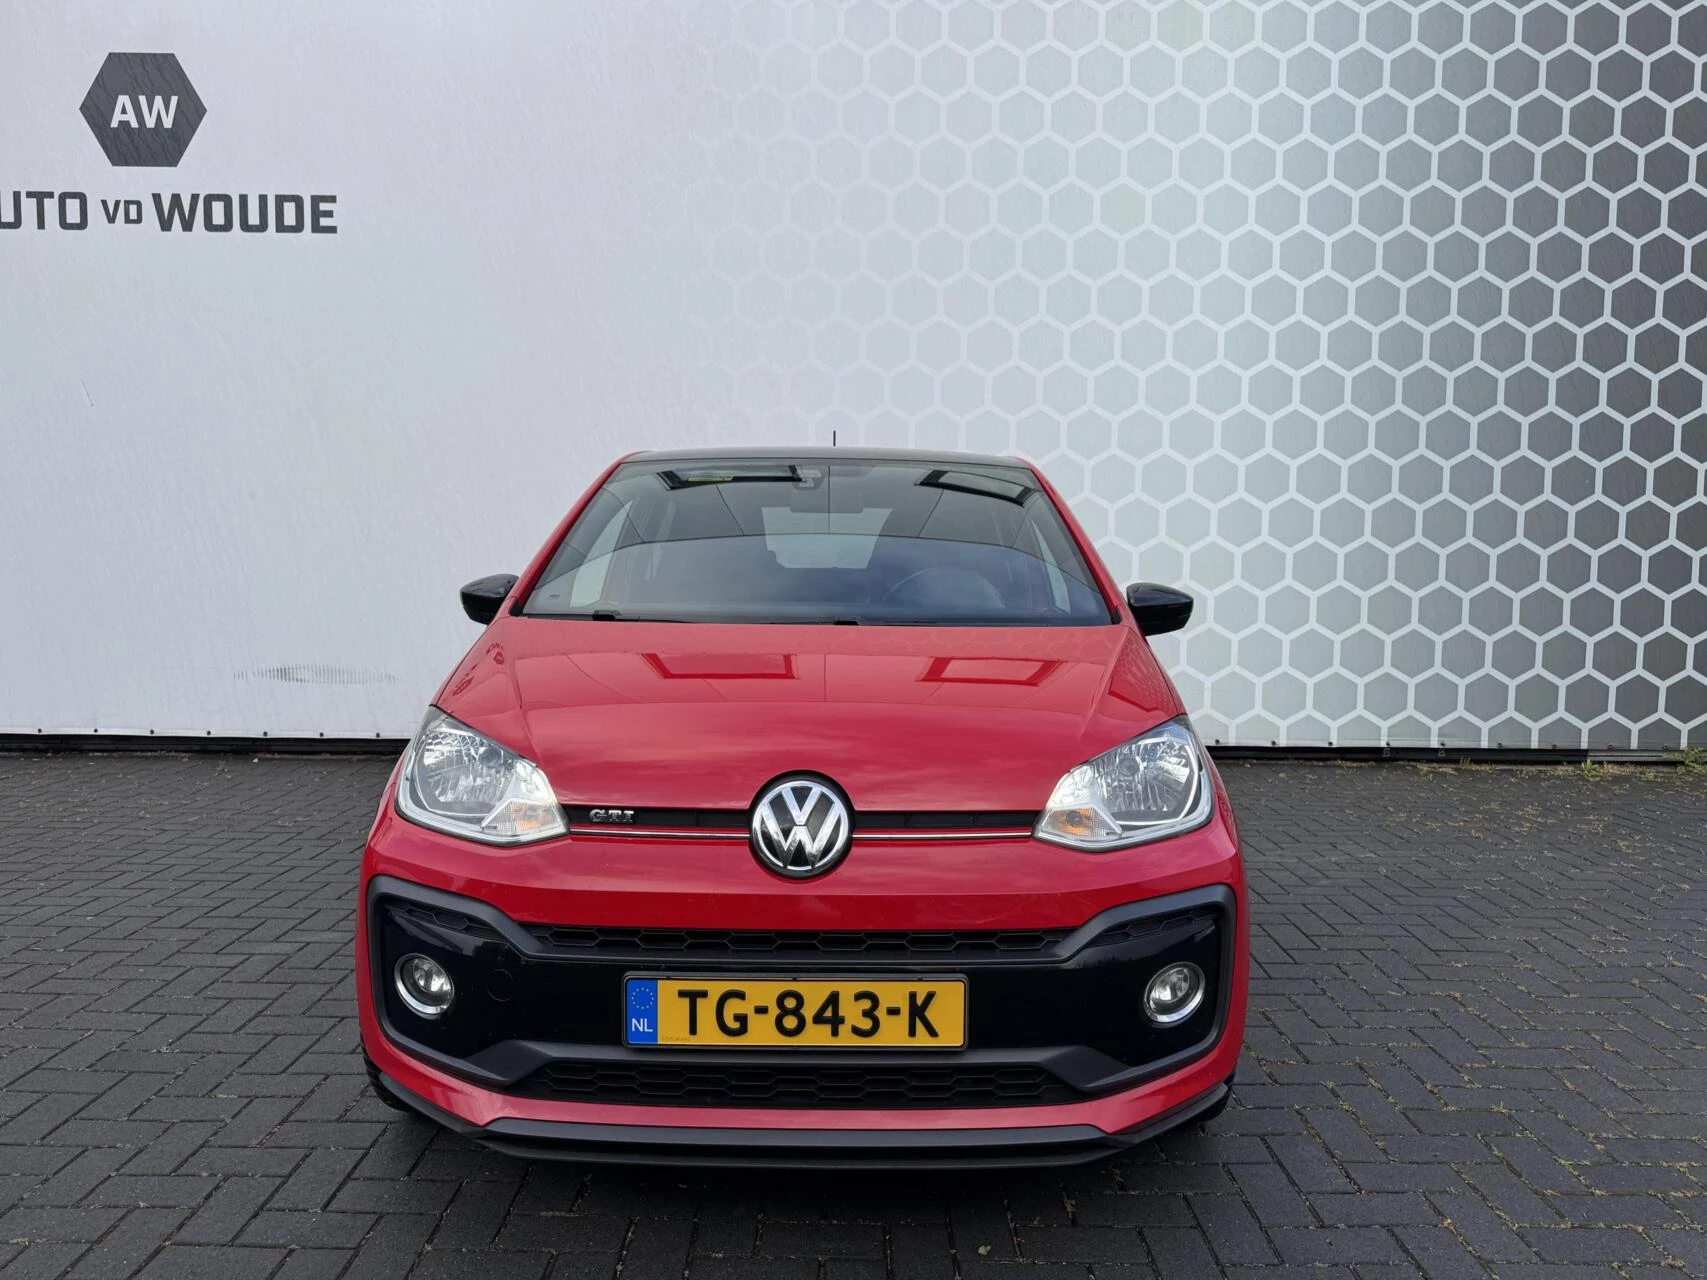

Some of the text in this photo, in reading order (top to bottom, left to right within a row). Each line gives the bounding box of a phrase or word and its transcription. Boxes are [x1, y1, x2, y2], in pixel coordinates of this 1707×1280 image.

[110, 95, 179, 129] AW
[100, 199, 143, 225] VD
[151, 192, 338, 234] WOUDE
[589, 809, 635, 823] GTI
[632, 1017, 654, 1032] NL
[677, 988, 939, 1038] TG-843-K
